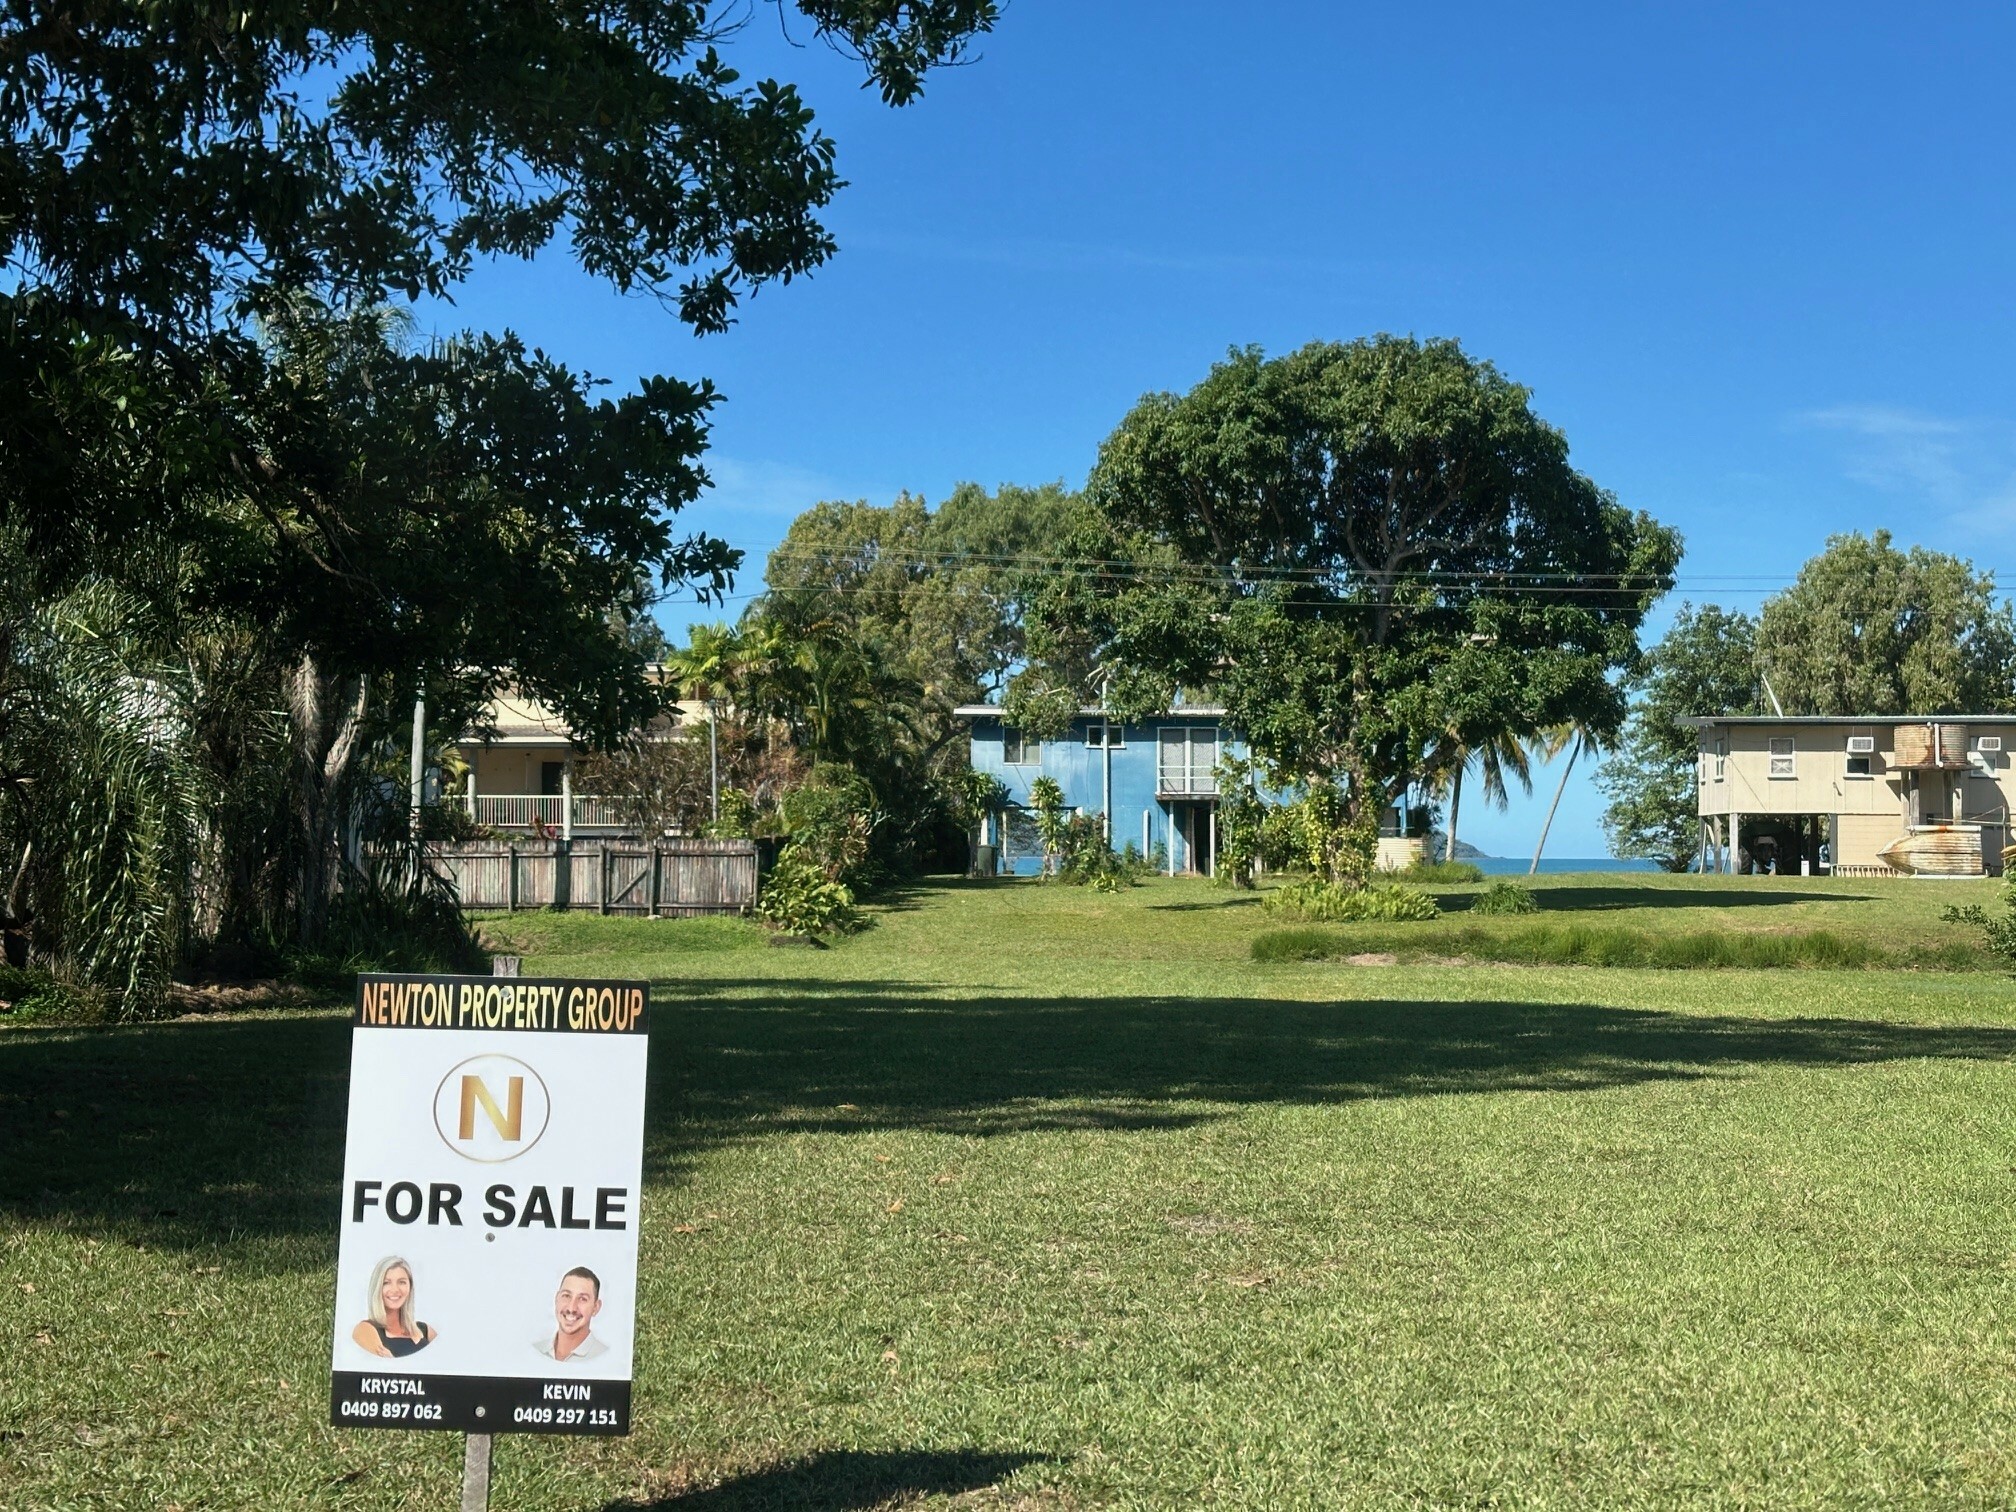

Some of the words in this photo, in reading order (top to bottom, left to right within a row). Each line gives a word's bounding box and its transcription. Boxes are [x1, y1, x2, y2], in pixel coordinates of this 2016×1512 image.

[362, 983, 454, 1026] NEWTON
[459, 984, 564, 1029] PROPERTY
[568, 987, 644, 1031] GROUP
[458, 1075, 524, 1141] N
[352, 1180, 463, 1226] FOR
[482, 1184, 628, 1231] SALE
[361, 1378, 426, 1395] KRYSTAL
[543, 1384, 591, 1400] KEVIN
[341, 1401, 377, 1417] 0409
[381, 1402, 410, 1418] 897
[413, 1404, 442, 1420] 062
[513, 1407, 551, 1423] 0409
[555, 1408, 585, 1424] 297
[589, 1409, 617, 1425] 151
